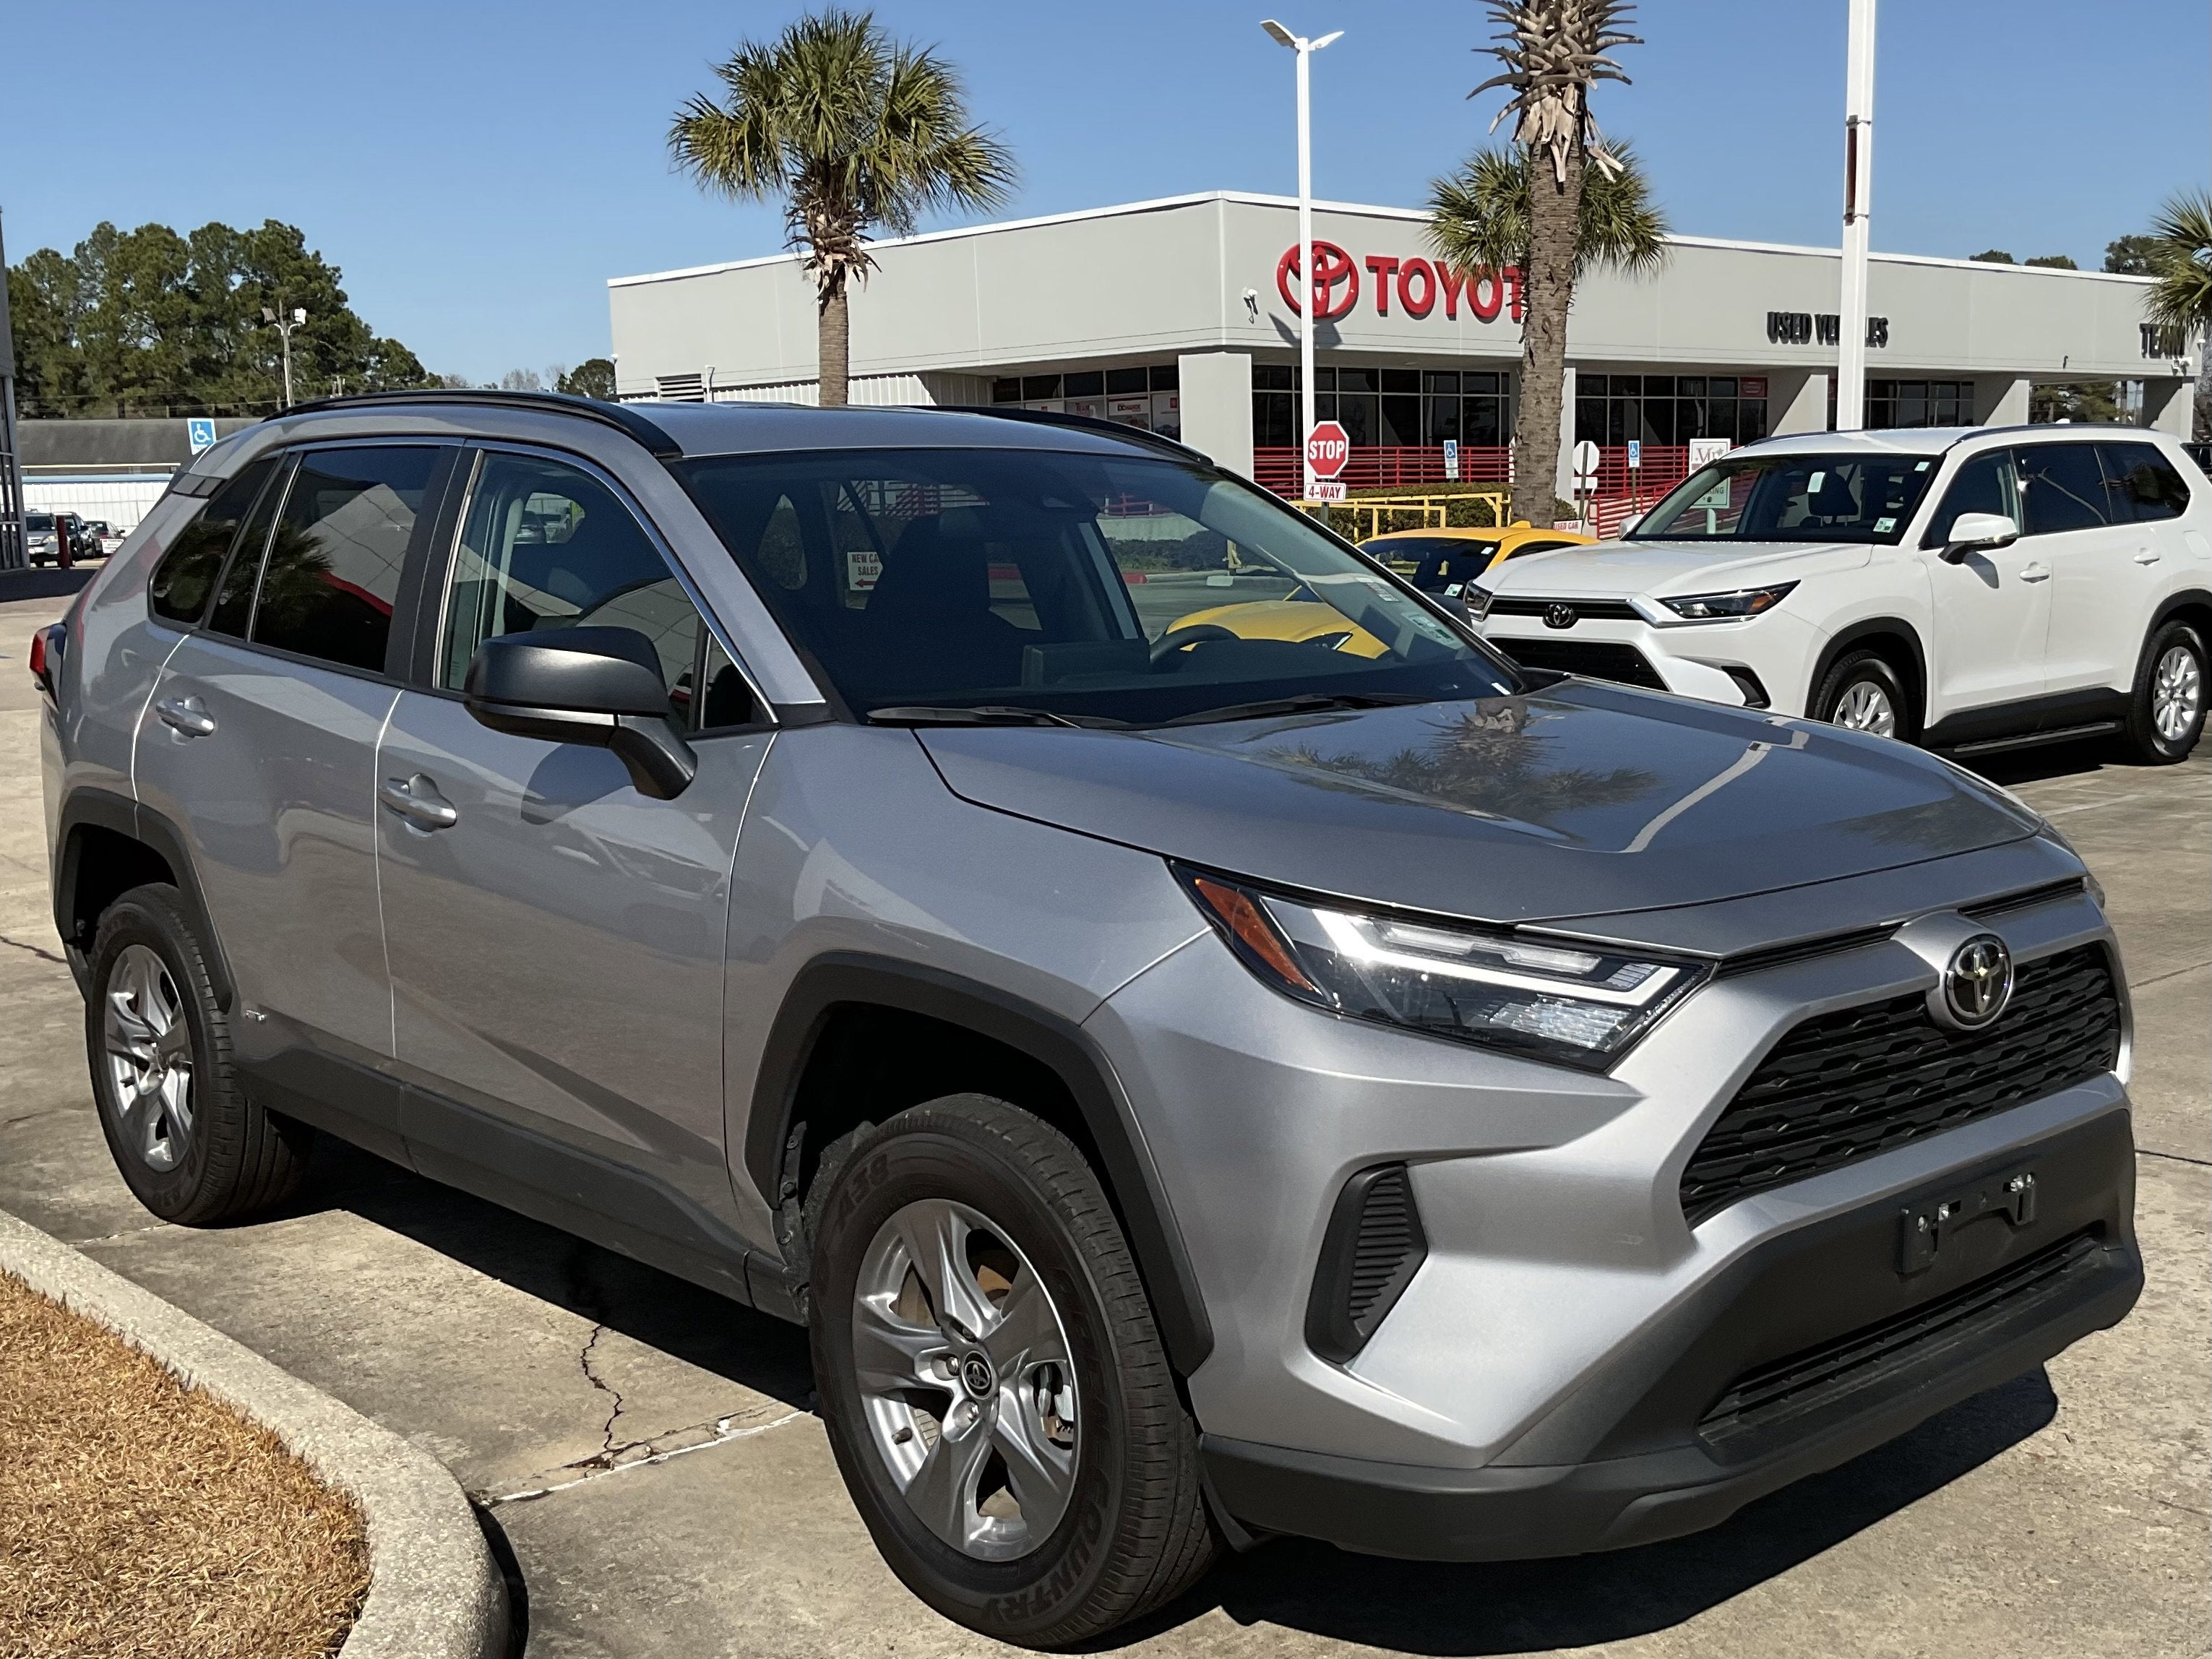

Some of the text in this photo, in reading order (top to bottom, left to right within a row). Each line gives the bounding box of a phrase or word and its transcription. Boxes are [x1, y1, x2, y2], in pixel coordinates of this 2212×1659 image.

[1366, 256, 1523, 324] TOYOT
[1767, 311, 1812, 344] USED
[1309, 440, 1345, 460] STOP
[1309, 486, 1341, 499] 4-WAY
[852, 553, 879, 564] NEW CA
[858, 566, 879, 575] SALES
